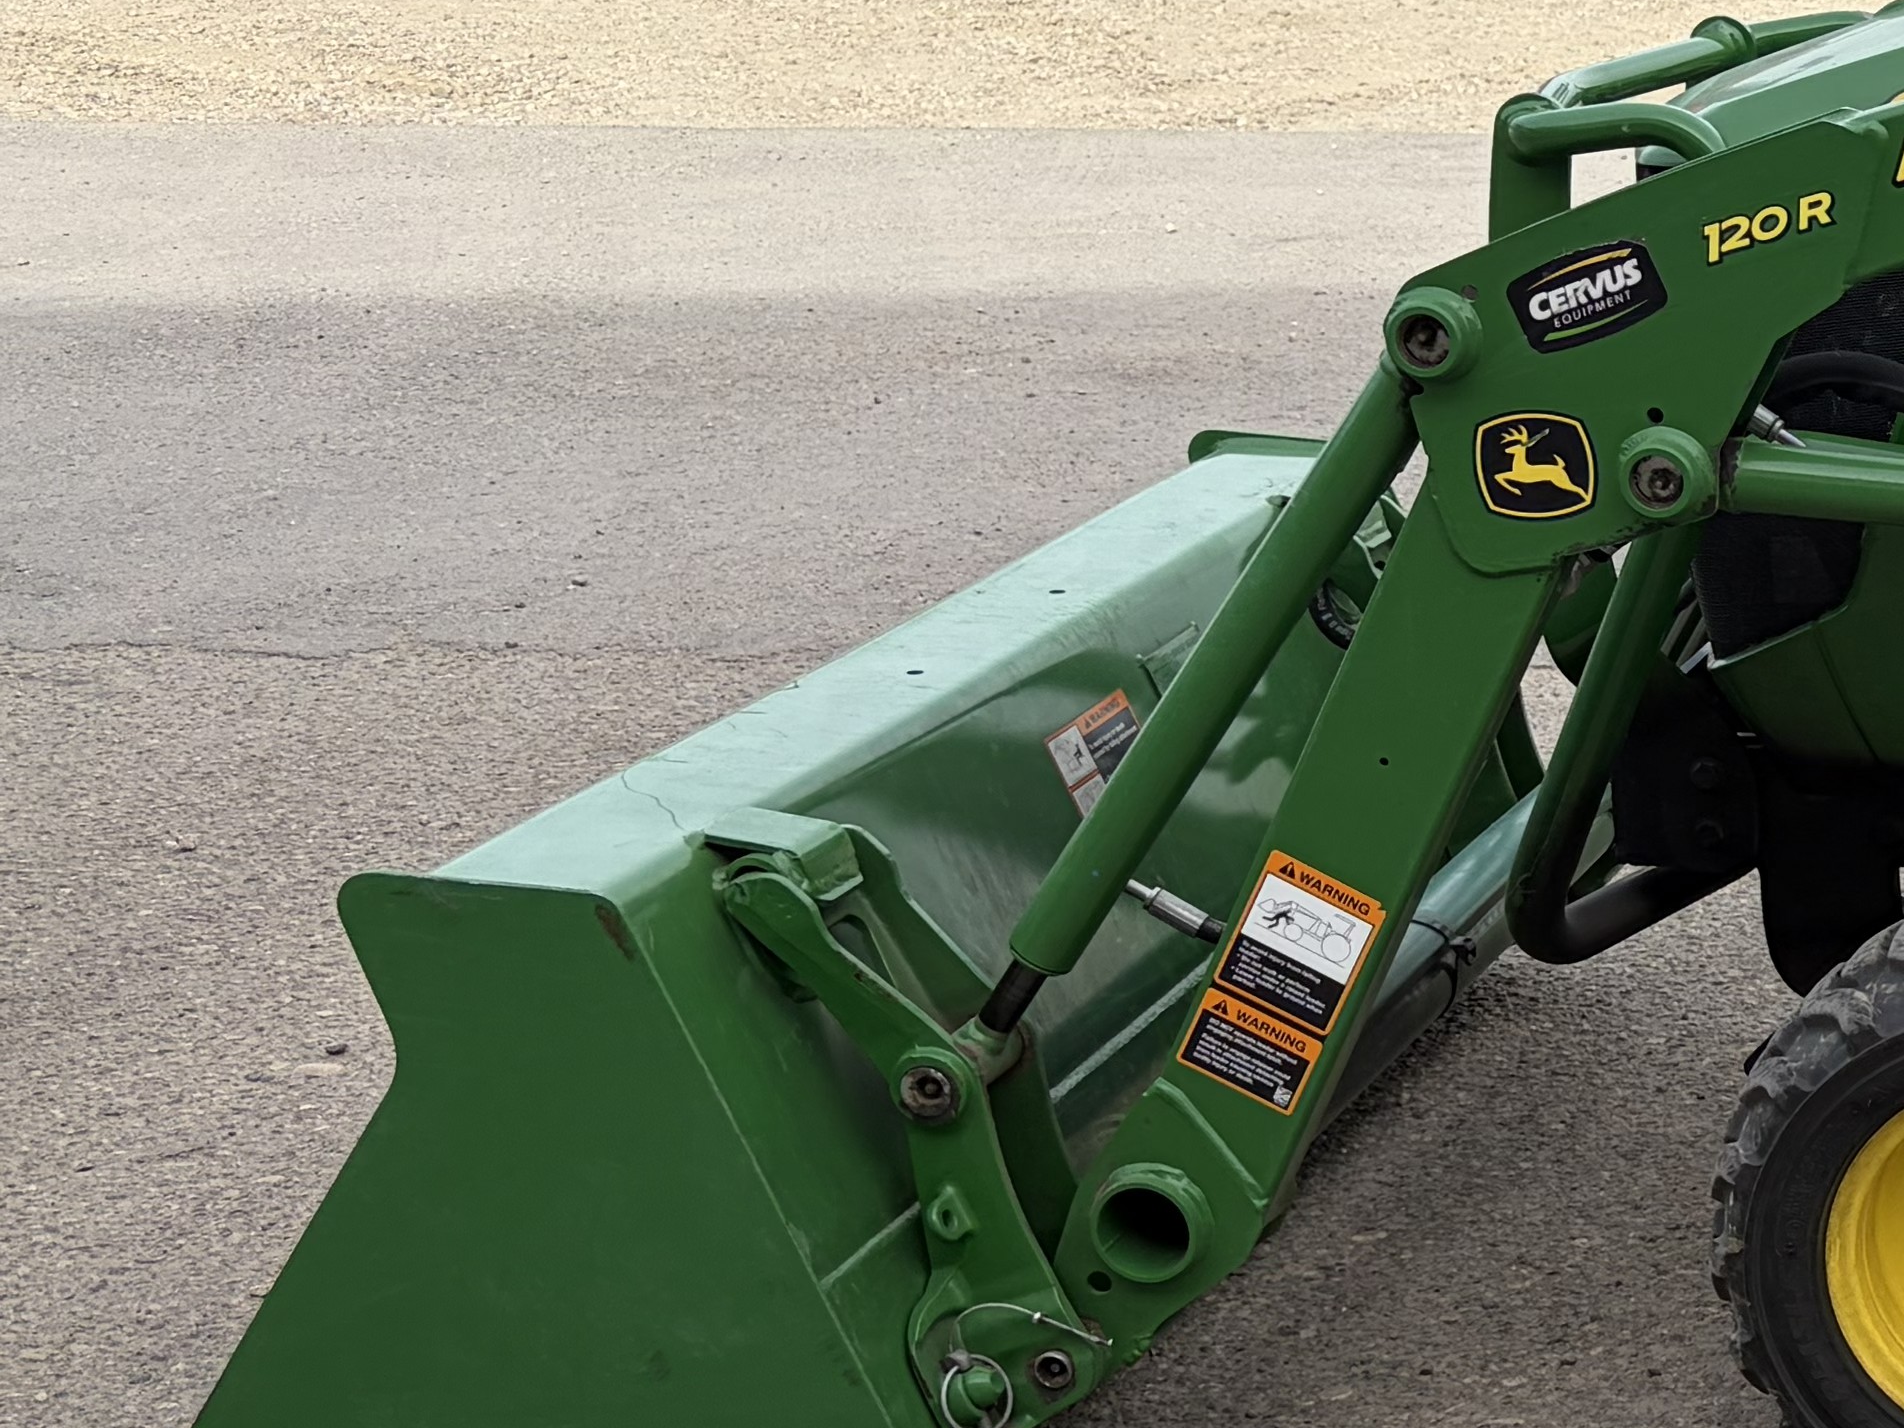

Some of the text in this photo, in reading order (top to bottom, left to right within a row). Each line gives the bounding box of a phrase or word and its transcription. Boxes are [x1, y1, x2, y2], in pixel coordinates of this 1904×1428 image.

[1703, 191, 1833, 263] 120 R
[1528, 257, 1643, 321] CERVUS
[1553, 289, 1633, 329] EQUIPMENT
[1300, 871, 1371, 916] WARNING
[1236, 1009, 1307, 1054] WARNING
